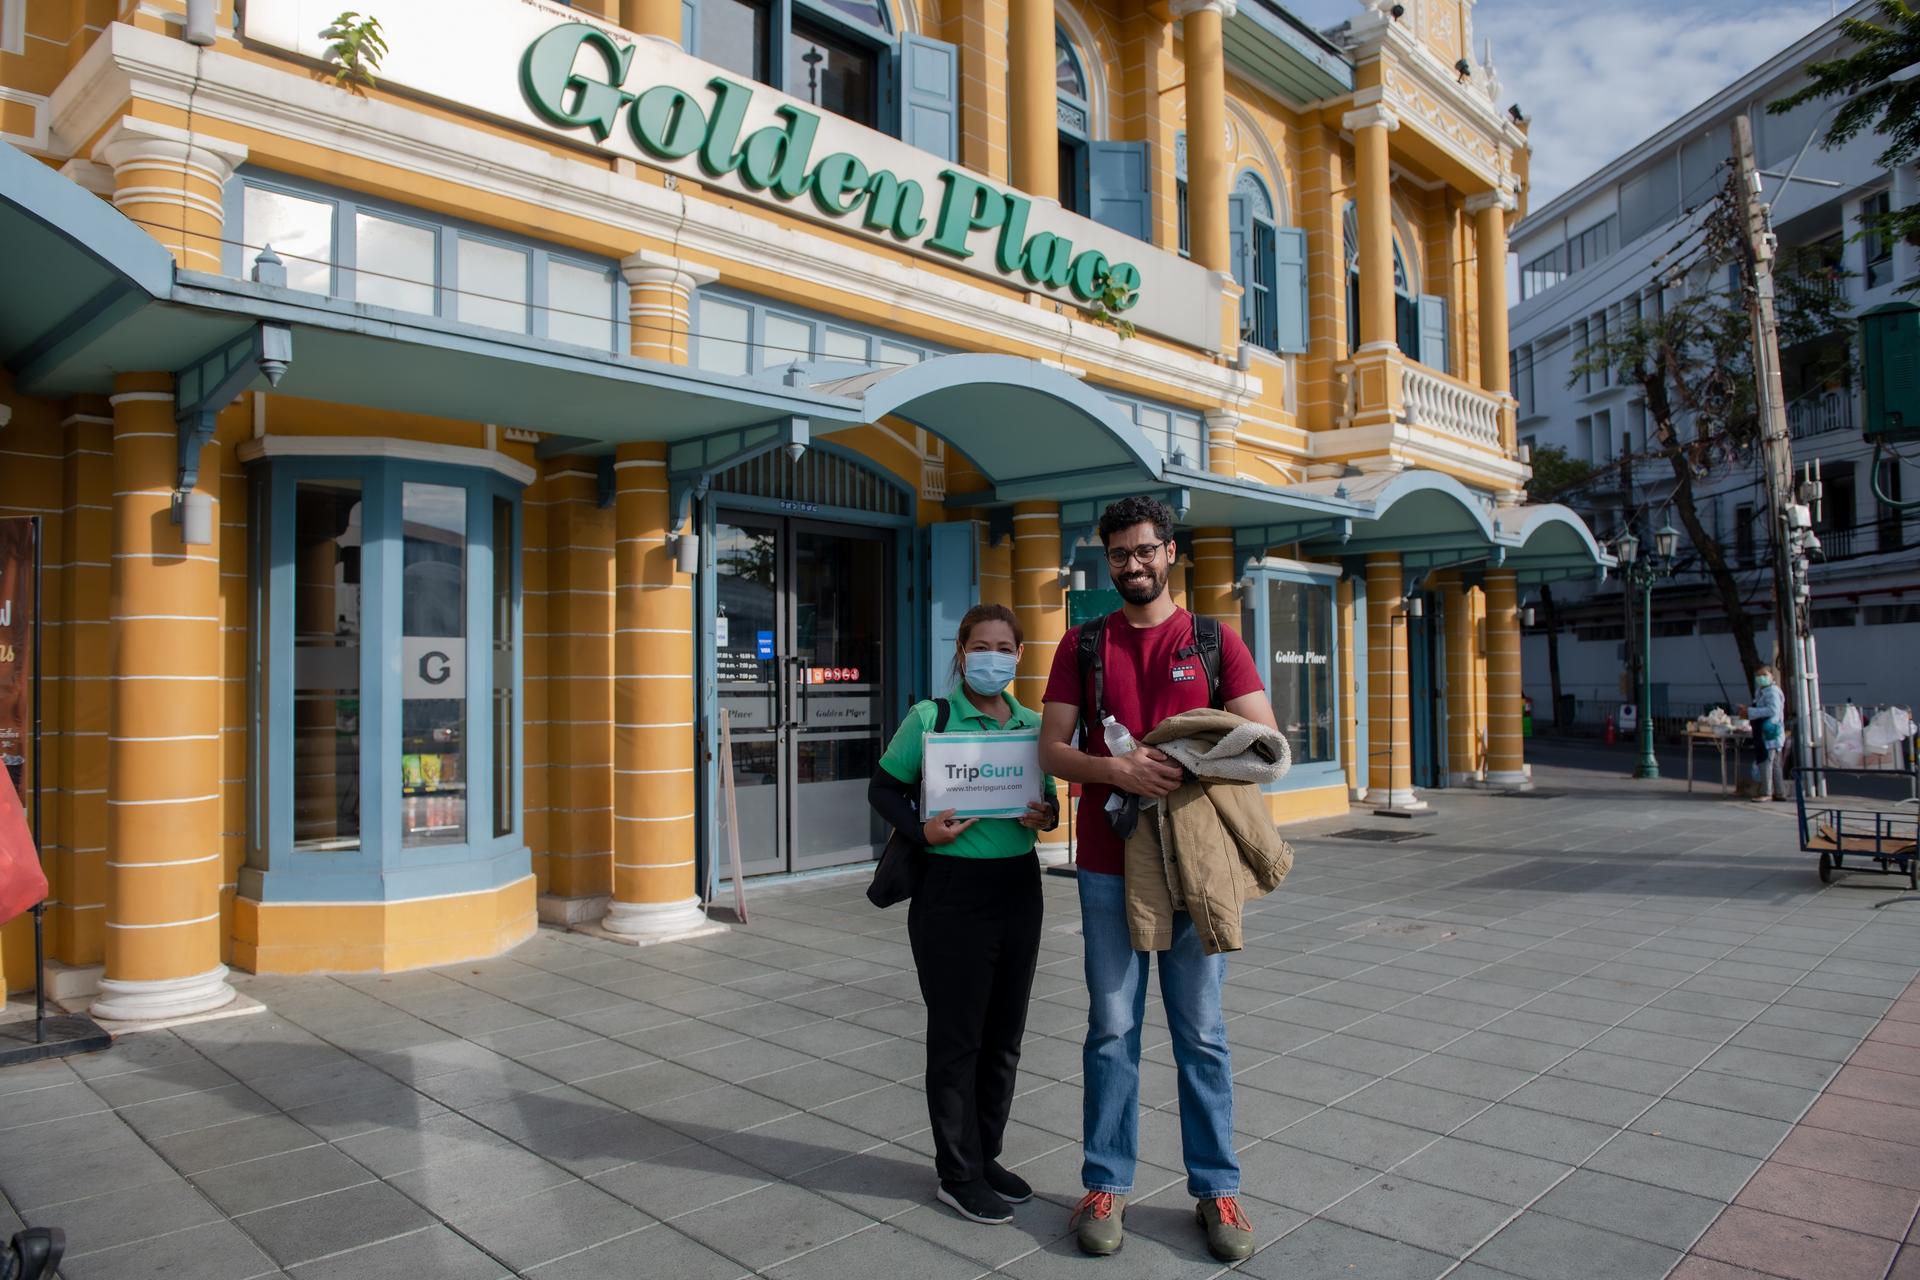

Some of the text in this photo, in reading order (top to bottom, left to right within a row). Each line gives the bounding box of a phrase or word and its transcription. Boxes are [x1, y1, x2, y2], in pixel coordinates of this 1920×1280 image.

[519, 22, 1142, 312] Golden Place
[1275, 650, 1327, 664] Golden Place
[419, 651, 451, 685] G
[815, 709, 843, 718] Golden
[945, 763, 1024, 782] TripGuru
[945, 783, 1023, 793] www.thetripguru.com
